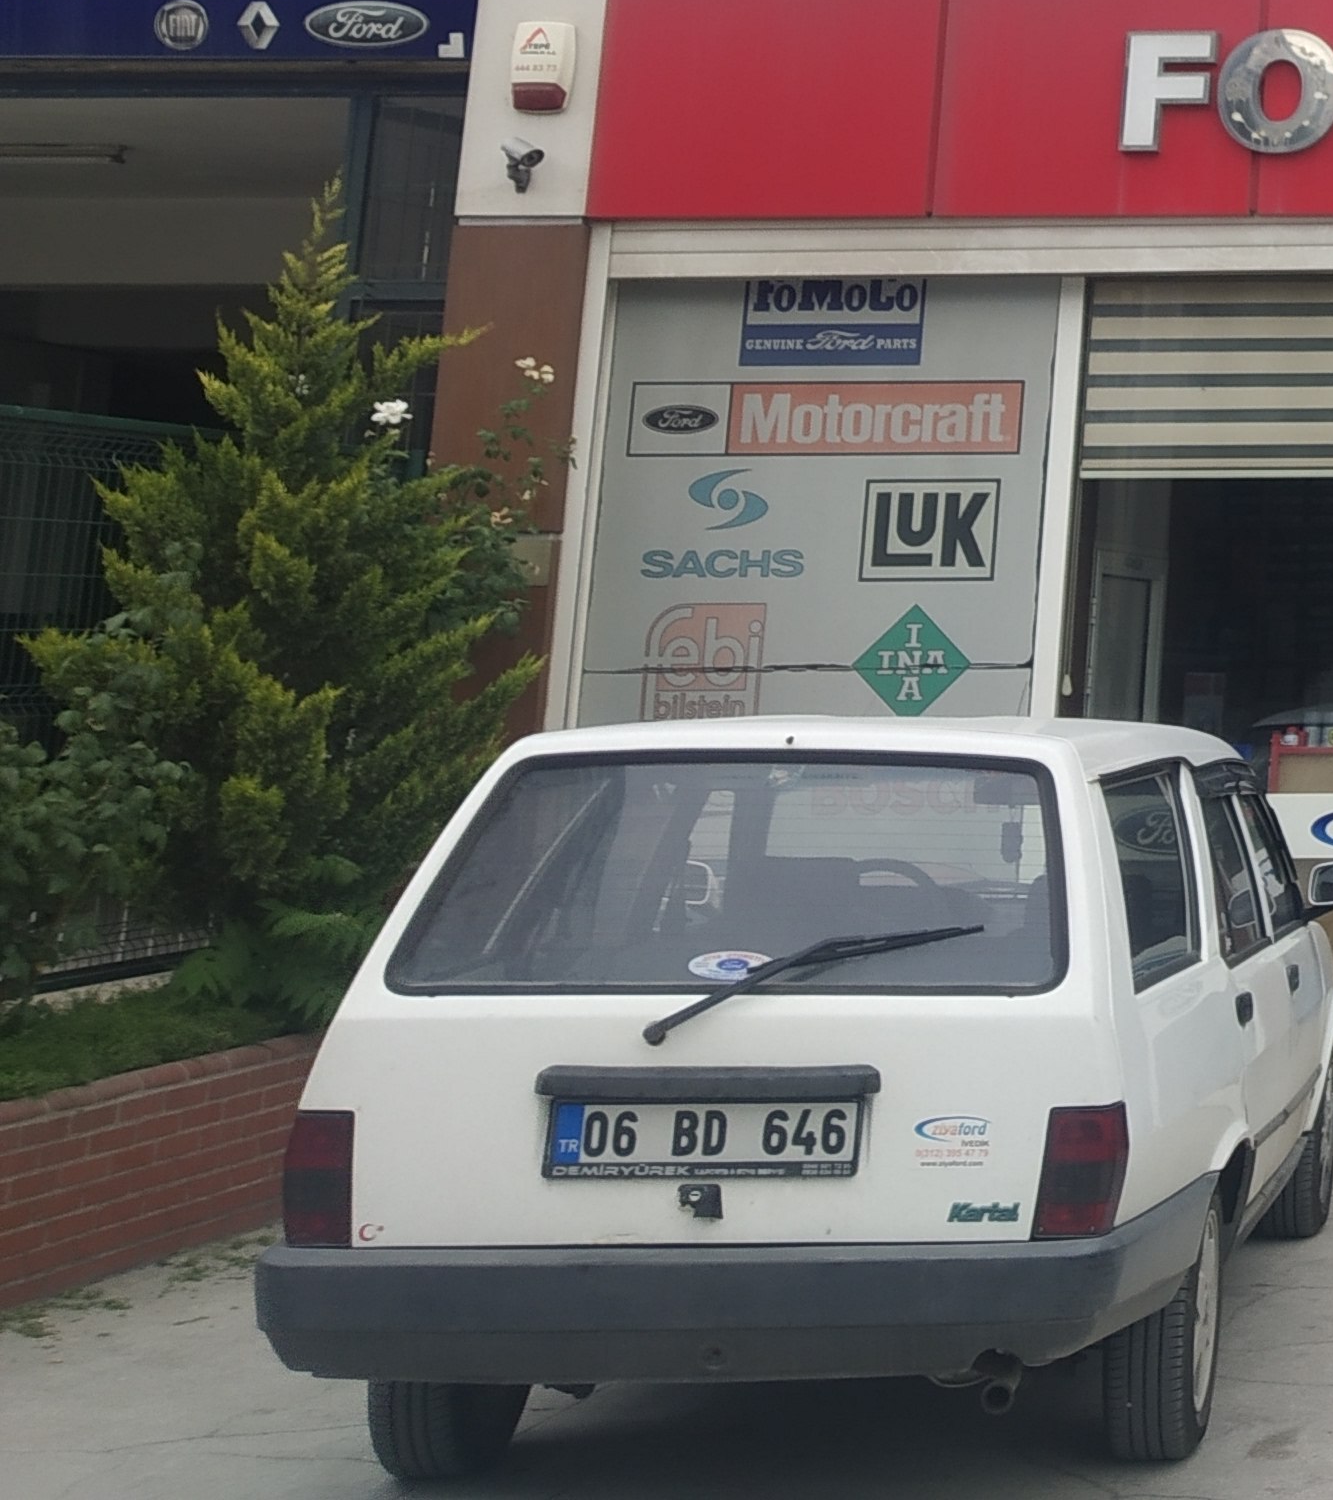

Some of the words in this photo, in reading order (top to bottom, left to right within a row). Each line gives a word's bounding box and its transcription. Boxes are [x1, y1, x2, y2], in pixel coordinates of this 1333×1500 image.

[168, 14, 198, 38] FIAT
[328, 7, 404, 42] Ford
[745, 338, 804, 350] GENUINE
[805, 329, 876, 351] Ford
[876, 338, 917, 350] PARTS
[656, 406, 705, 431] Ford
[739, 392, 1007, 444] Motorcraft
[640, 549, 805, 579] SACHS
[655, 693, 745, 719] bilstein
[558, 1138, 579, 1153] TR
[583, 1110, 639, 1157] 06
[671, 1110, 728, 1157] BD
[762, 1108, 848, 1156] 646
[946, 1202, 1021, 1222] Kartal
